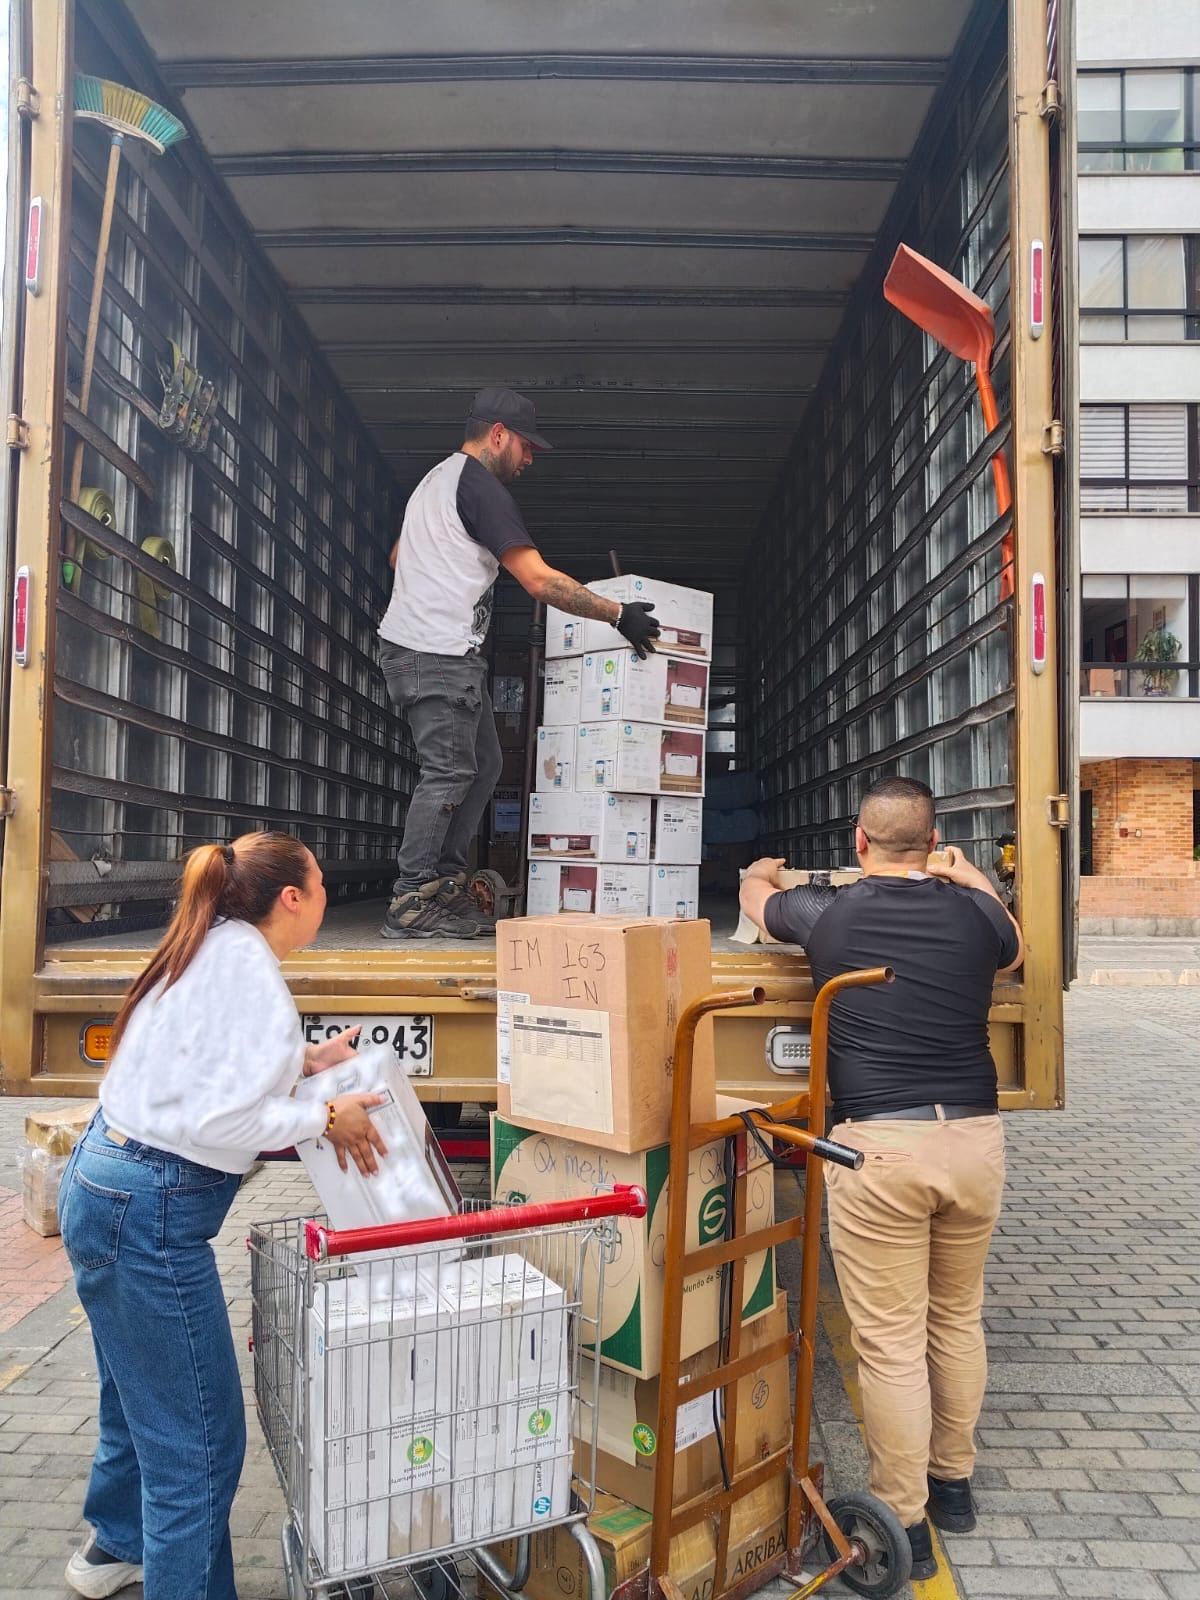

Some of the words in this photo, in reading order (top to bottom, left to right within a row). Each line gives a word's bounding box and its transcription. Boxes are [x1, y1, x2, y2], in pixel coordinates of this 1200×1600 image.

[509, 937, 542, 970] IM
[562, 942, 606, 971] 163
[562, 976, 599, 1005] IN
[683, 1279, 705, 1294] Mundo
[534, 1496, 552, 1515] hp
[732, 1530, 786, 1579] ARRIBA
